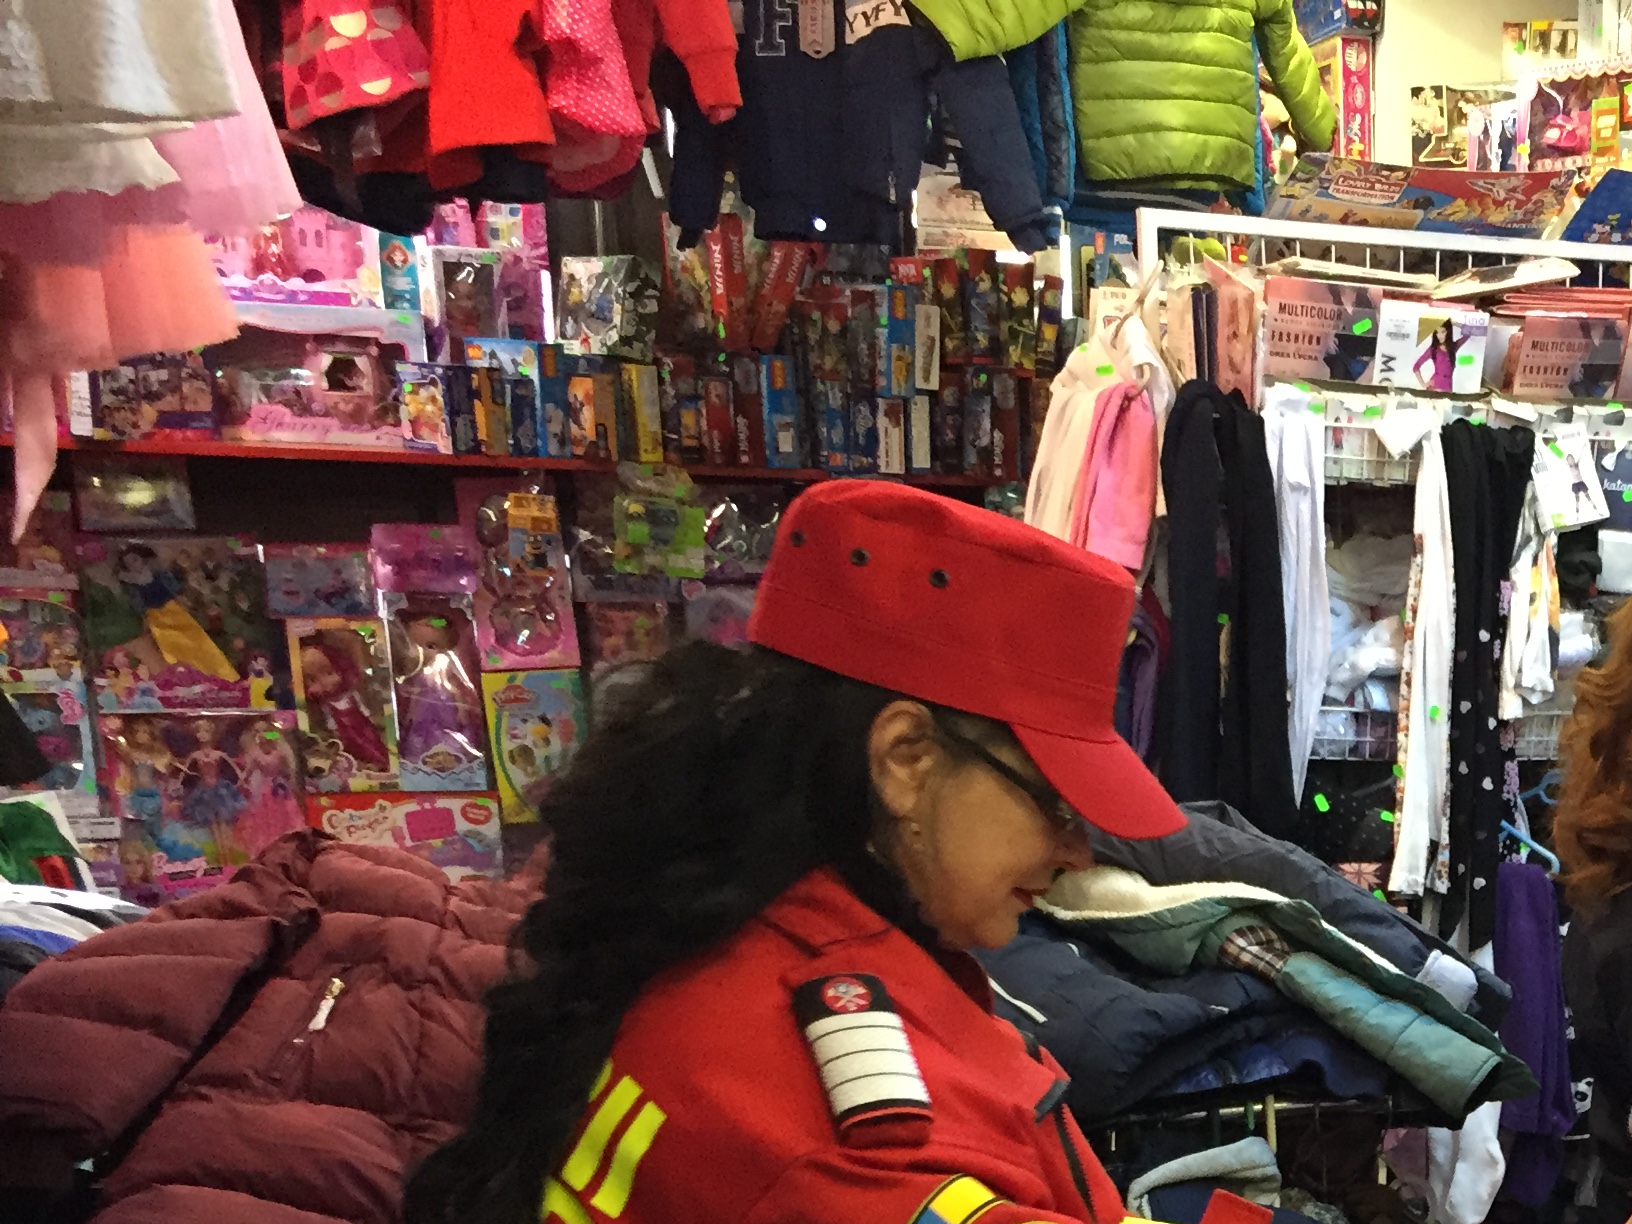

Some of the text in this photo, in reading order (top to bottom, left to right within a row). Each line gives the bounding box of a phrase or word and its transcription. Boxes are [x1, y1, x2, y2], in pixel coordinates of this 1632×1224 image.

[710, 241, 724, 295] NINJA
[1278, 302, 1343, 321] MULTICOLOR
[1271, 330, 1321, 346] FASHION
[1531, 340, 1589, 353] MULTICOLOR
[1522, 365, 1569, 376] FASHION
